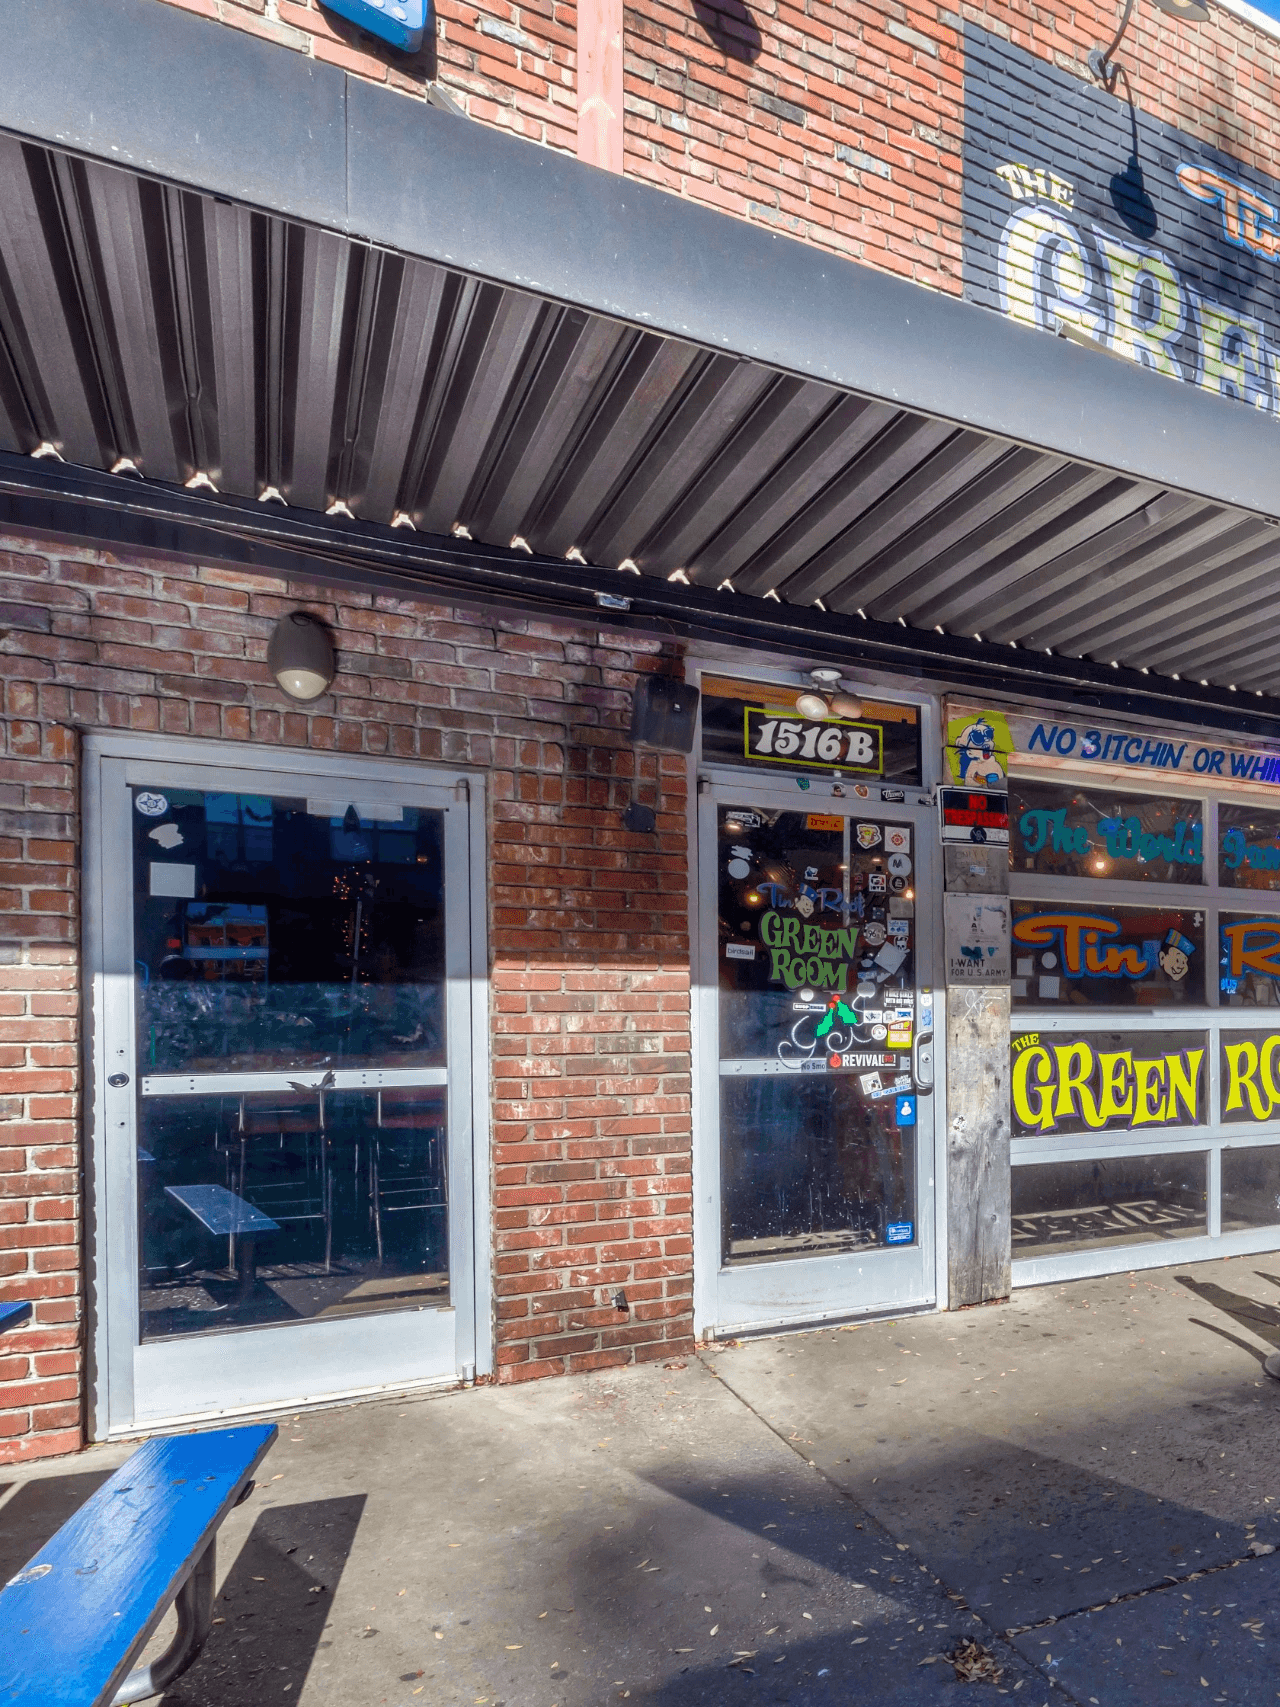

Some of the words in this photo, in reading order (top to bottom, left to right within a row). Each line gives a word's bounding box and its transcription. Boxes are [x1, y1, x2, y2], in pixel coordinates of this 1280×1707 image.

[996, 163, 1075, 213] THE
[755, 720, 843, 761] 1516
[845, 731, 874, 764] B
[1028, 723, 1077, 755] NO
[1193, 748, 1226, 774] OR
[969, 794, 987, 810] NO
[1019, 808, 1091, 854] The
[1097, 815, 1204, 865] World
[757, 883, 793, 908] Tin
[818, 888, 865, 918] Roof
[761, 912, 859, 959] GREEN
[1012, 911, 1151, 979] Tin
[770, 949, 849, 991] ROOM
[958, 959, 985, 967] WANT
[985, 969, 1006, 977] ARMY
[842, 1055, 884, 1067] REVIVAL
[1012, 1033, 1040, 1052] THE
[802, 1063, 811, 1071] No
[1012, 1041, 1204, 1132] GREEN
